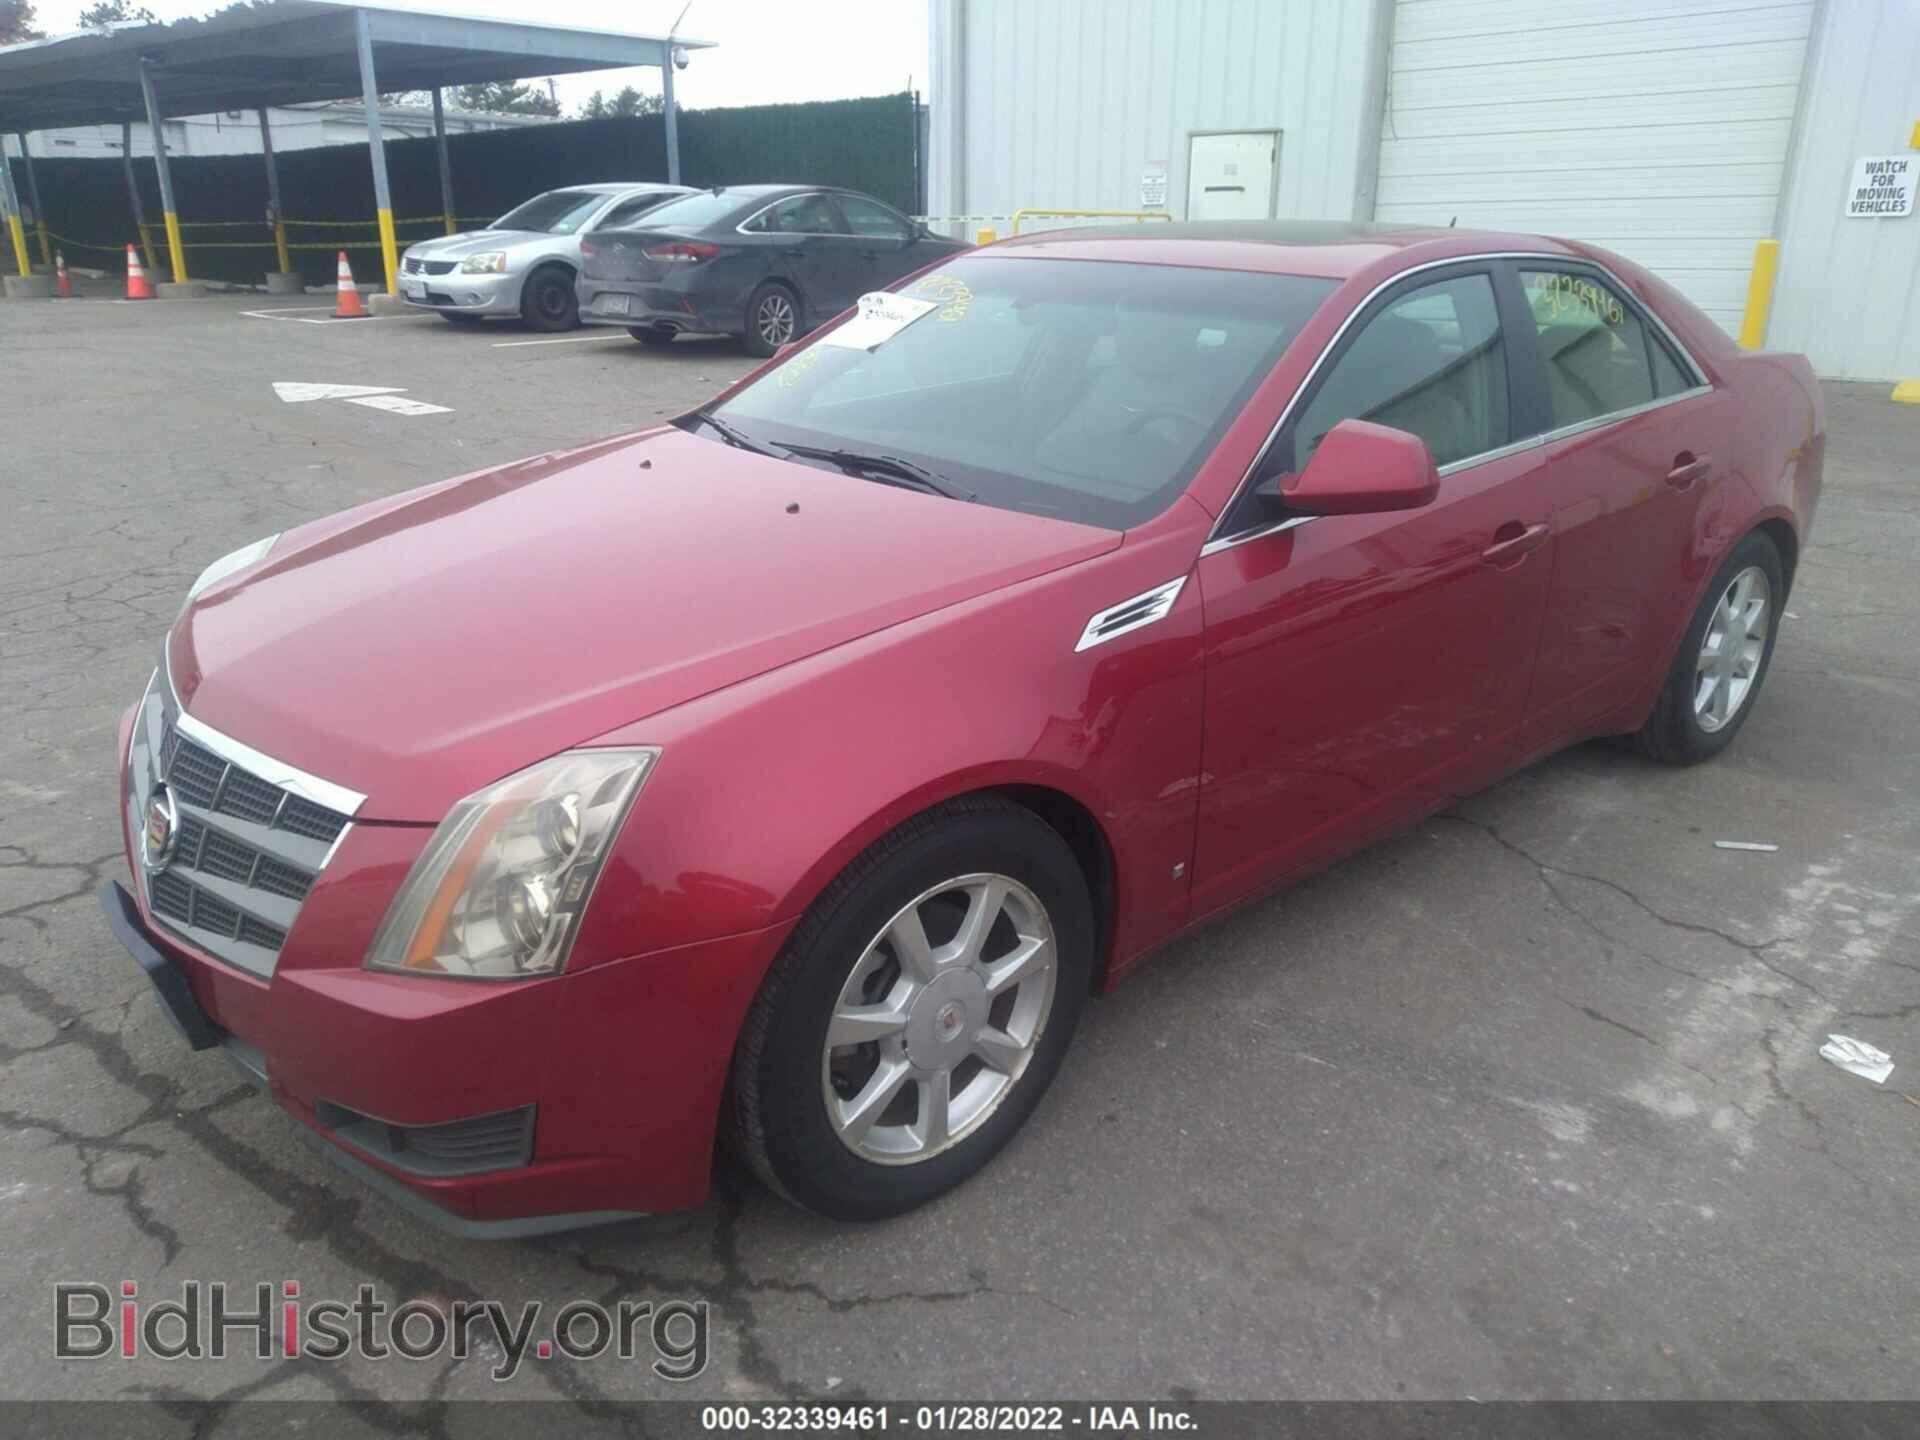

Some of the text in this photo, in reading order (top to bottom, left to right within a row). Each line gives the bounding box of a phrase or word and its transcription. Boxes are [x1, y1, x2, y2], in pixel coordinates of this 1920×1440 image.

[1865, 159, 1908, 174] WATCH
[1870, 175, 1896, 187] FOR
[1856, 187, 1905, 200] MOVING
[1851, 200, 1907, 213] VEHICLES
